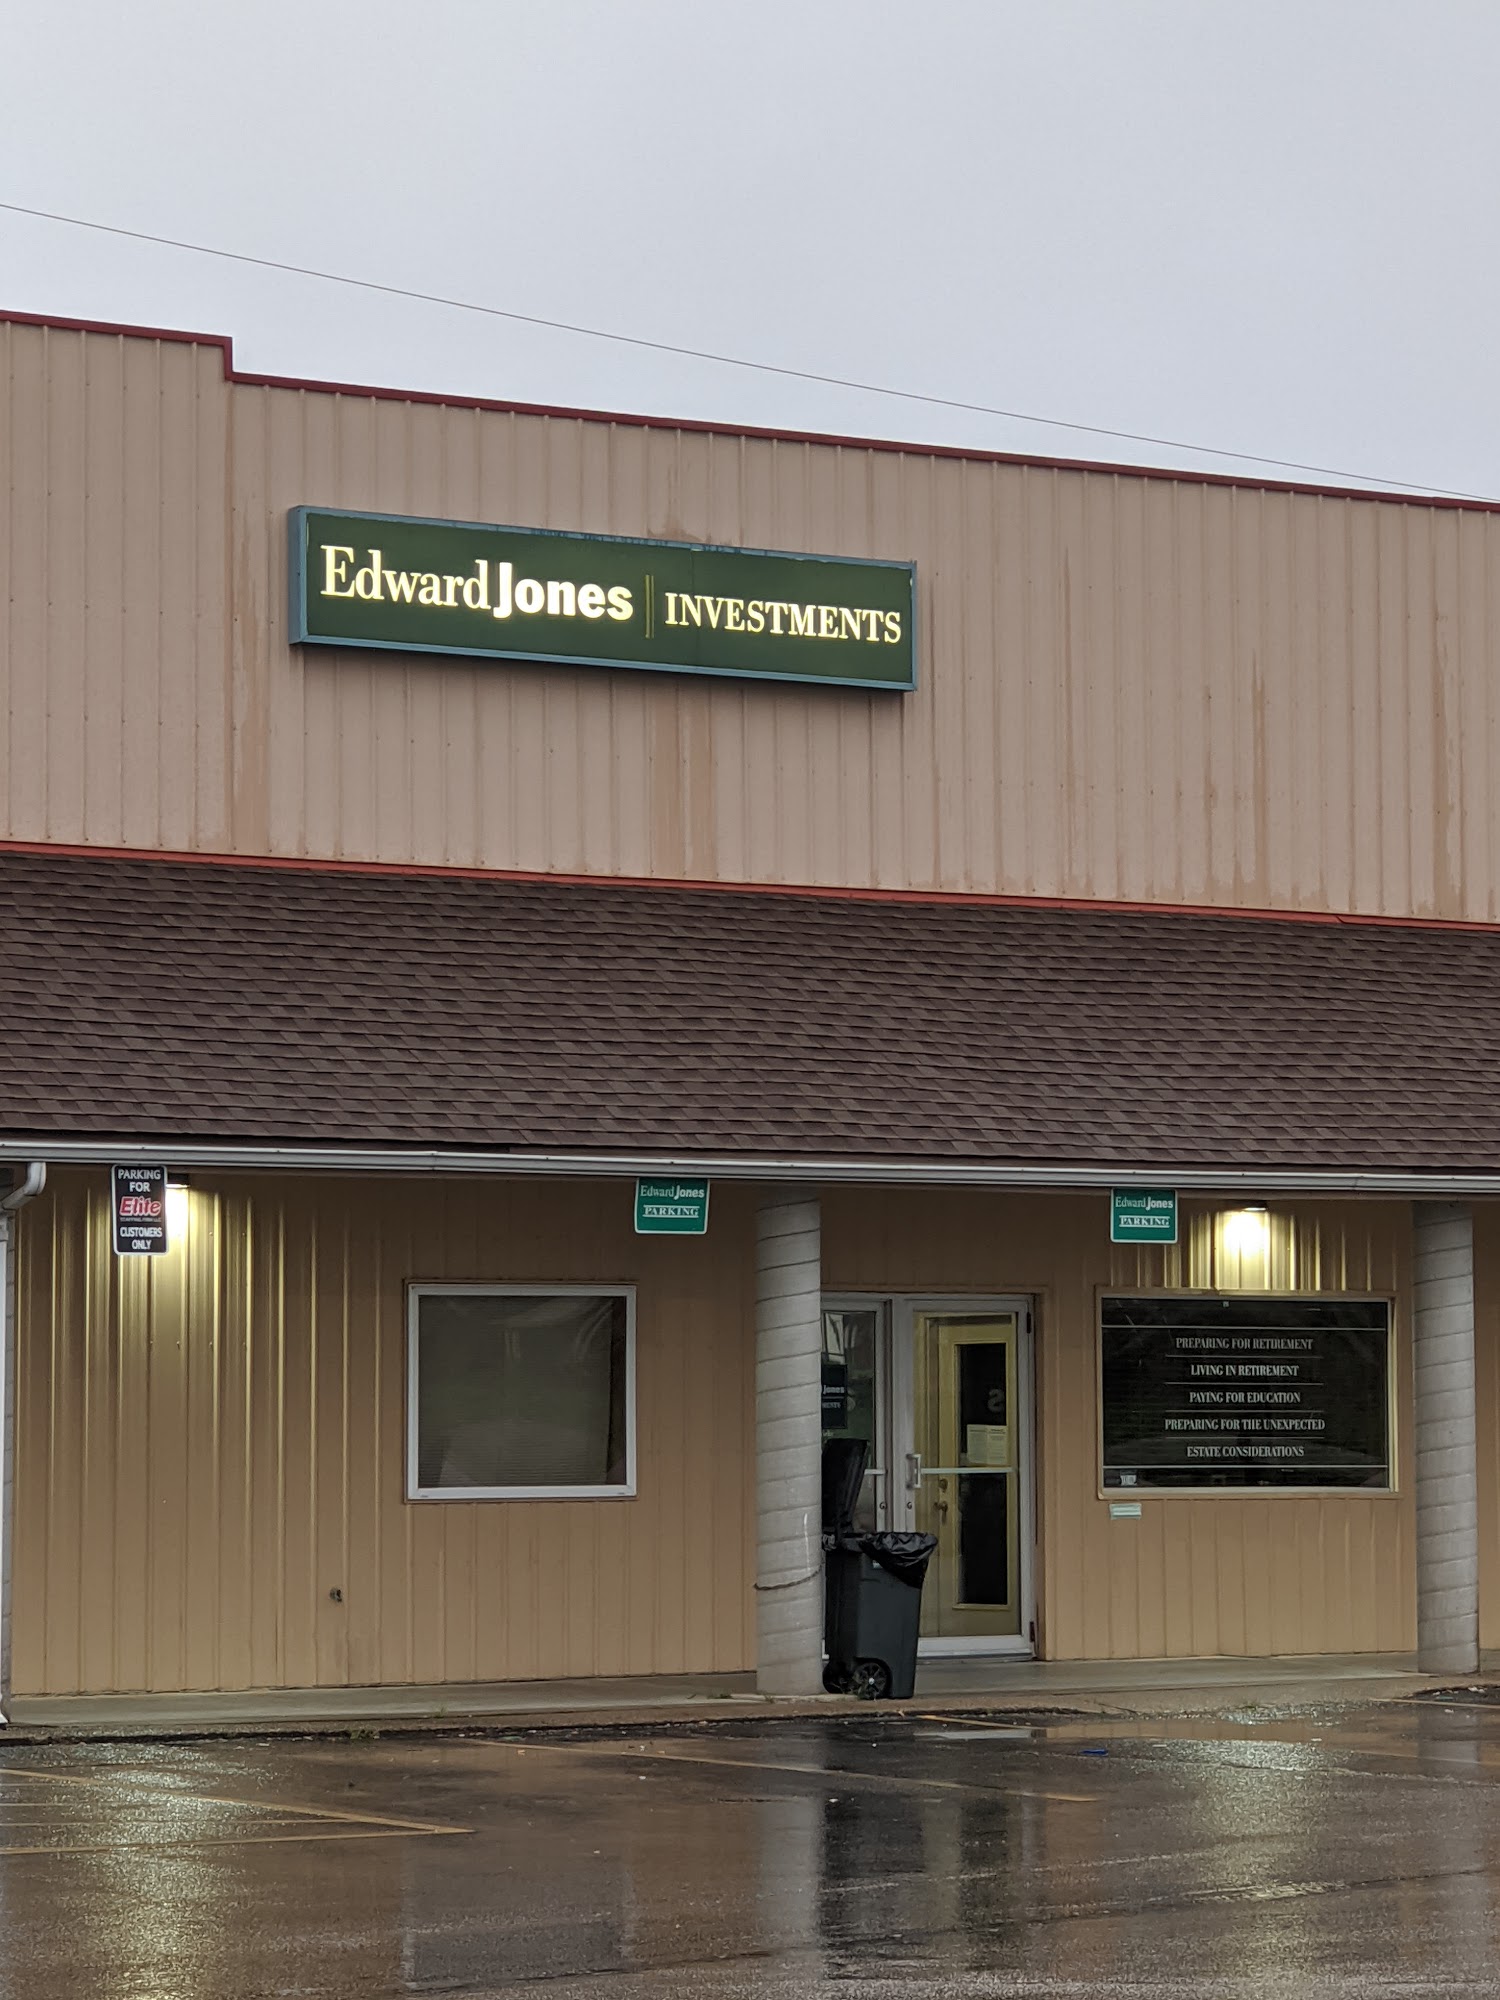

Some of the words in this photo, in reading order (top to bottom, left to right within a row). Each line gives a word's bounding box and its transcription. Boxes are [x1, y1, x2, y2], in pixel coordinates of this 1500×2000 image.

[664, 592, 902, 643] INVESTMENTS
[118, 1169, 161, 1180] PARKING
[129, 1181, 151, 1192] FOR
[119, 1196, 161, 1216] Elite
[644, 1206, 699, 1216] PARKING
[1120, 1216, 1170, 1226] PARKING
[120, 1226, 162, 1237] CUSTOMERS
[131, 1239, 152, 1250] ONLY
[1176, 1337, 1230, 1349] PREPARING
[1231, 1338, 1251, 1349] FOR
[1253, 1338, 1313, 1350] RETIREMENT
[1191, 1364, 1223, 1376] LIVING
[1225, 1365, 1237, 1376] IN
[1238, 1365, 1299, 1376] RETIREMENT
[1189, 1391, 1223, 1403] PAYING
[1225, 1391, 1245, 1403] FOR
[1247, 1391, 1300, 1403] EDUCATION
[1165, 1419, 1219, 1430] PREPARING
[1220, 1419, 1240, 1430] FOR
[1241, 1419, 1262, 1430] THE
[1263, 1419, 1325, 1430] UNEXPECTED
[1187, 1446, 1221, 1457] ESTATE
[1222, 1446, 1304, 1457] CONSIDERATIONS
